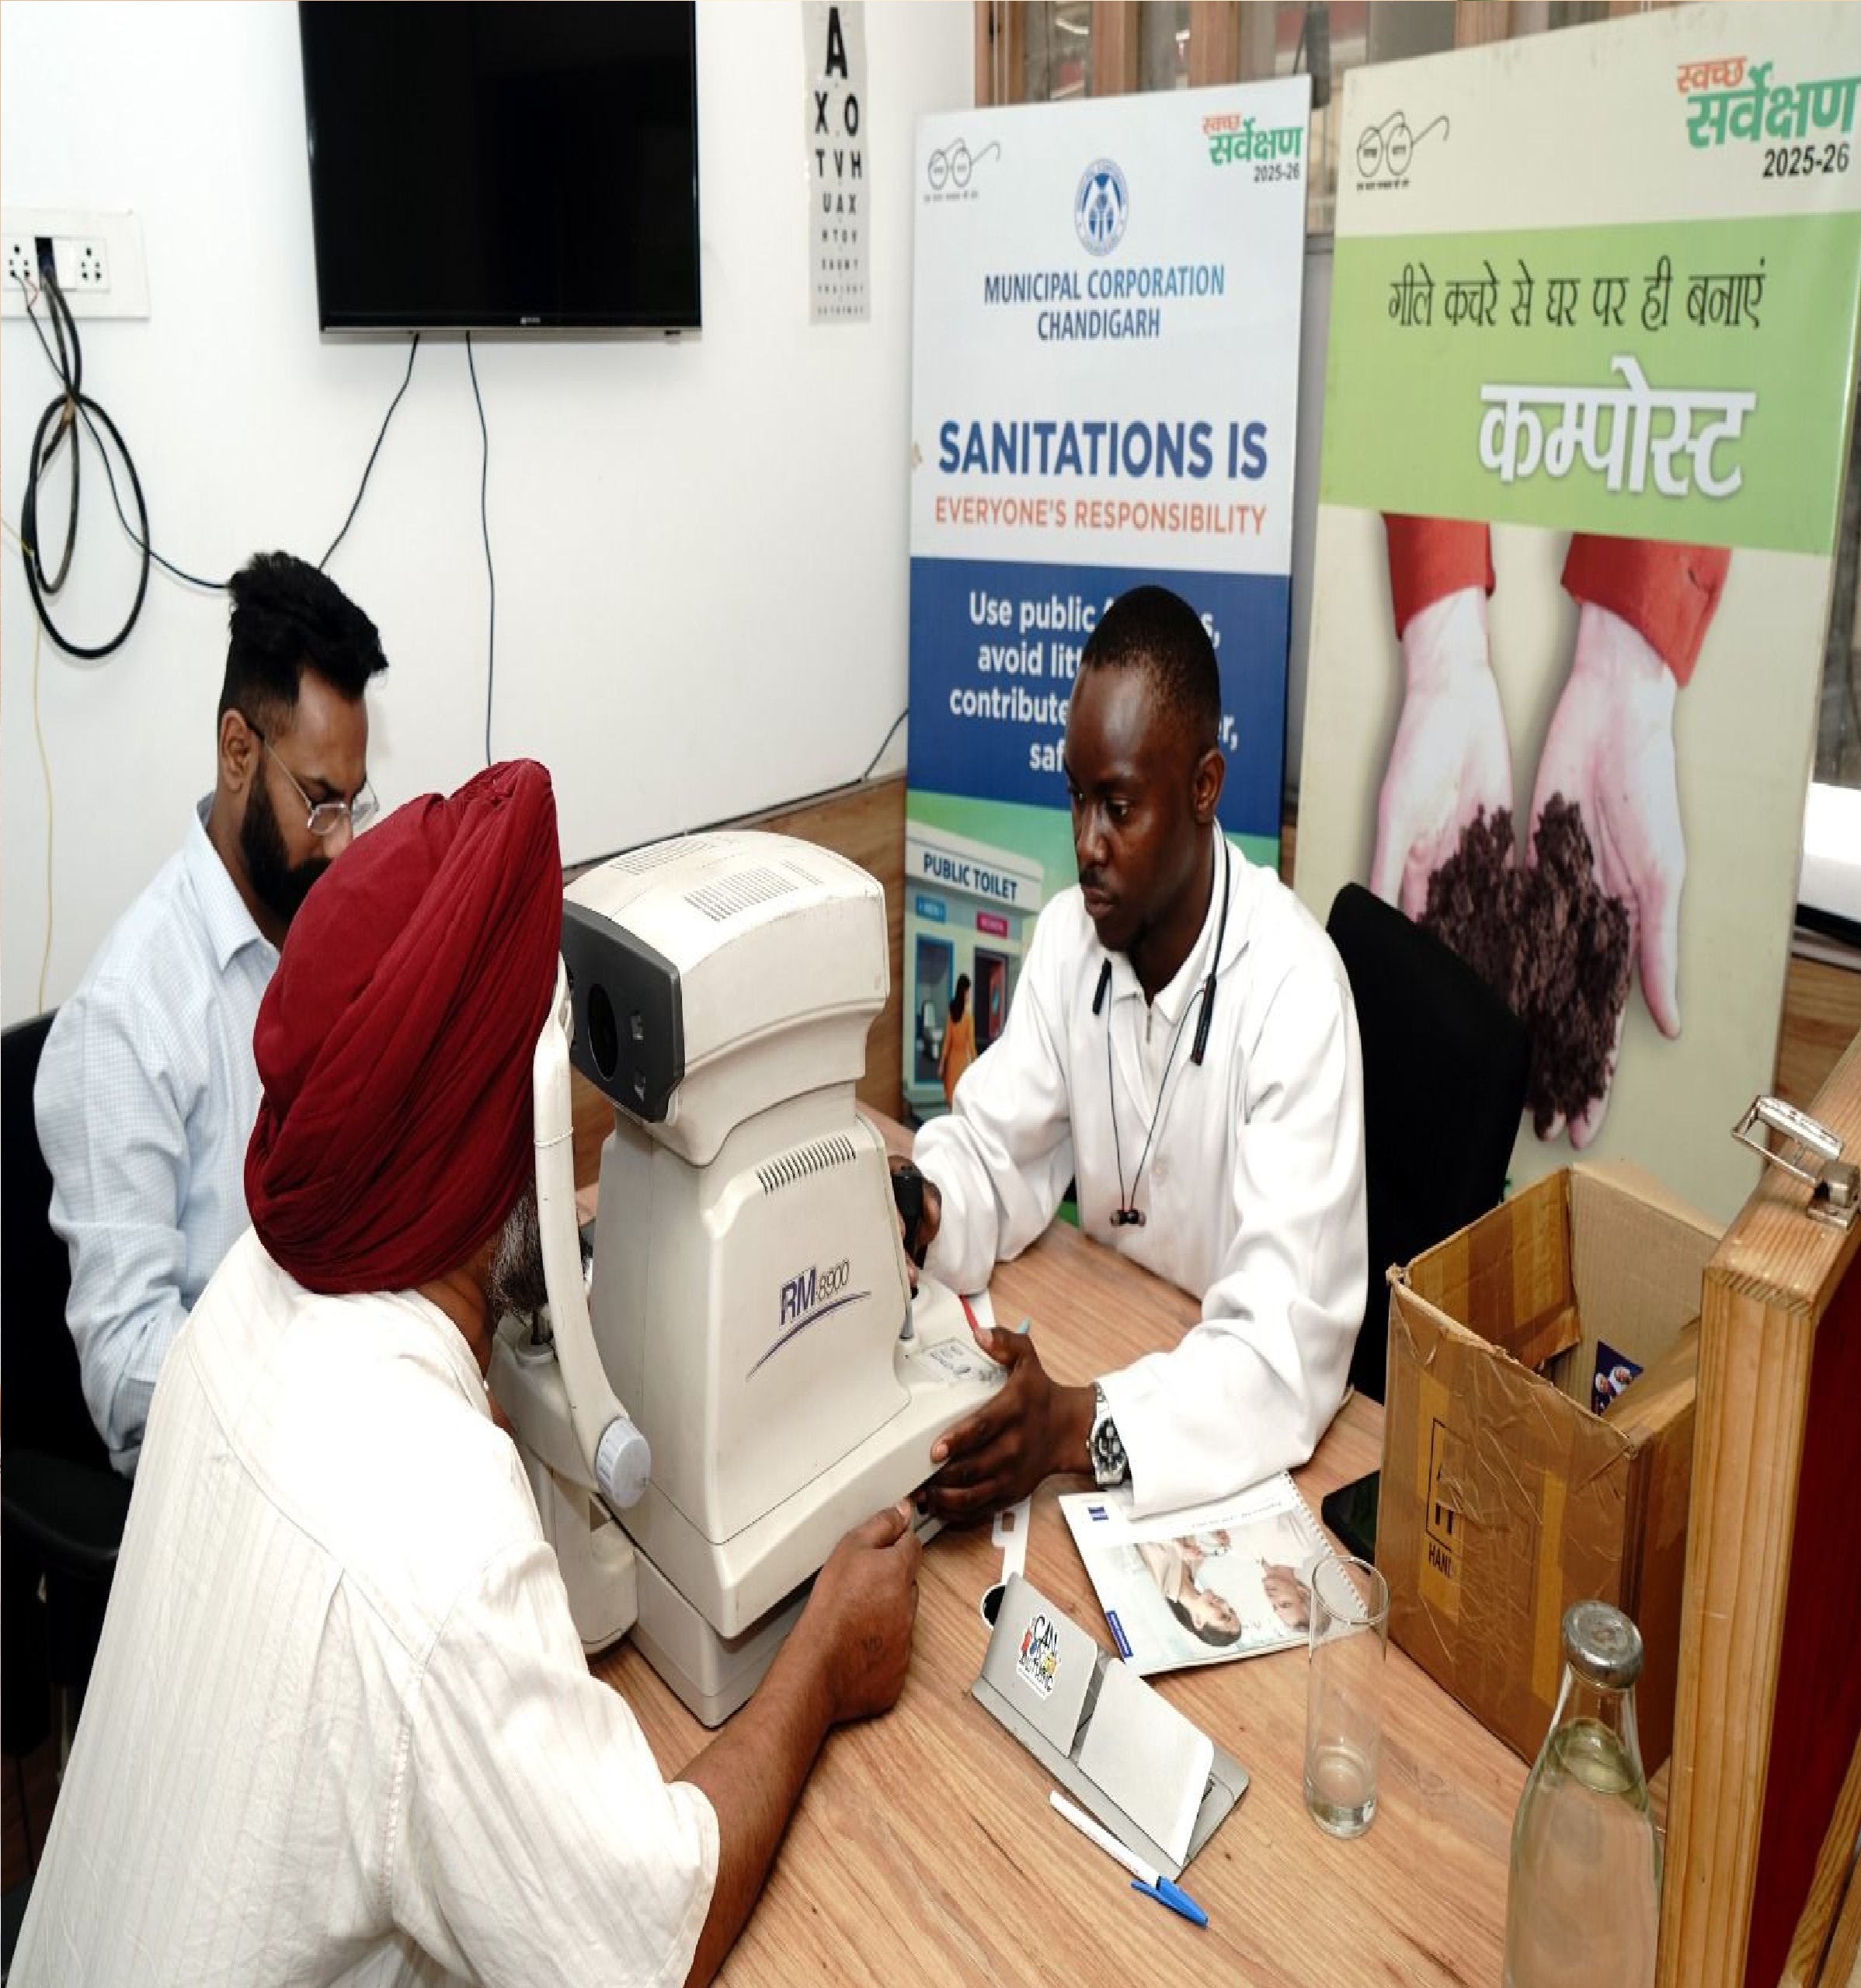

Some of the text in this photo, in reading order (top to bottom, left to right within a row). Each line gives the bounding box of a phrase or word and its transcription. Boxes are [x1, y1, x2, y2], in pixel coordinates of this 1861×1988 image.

[825, 7, 847, 79] A
[1677, 57, 1748, 94] स्वच्छ
[1685, 62, 1861, 149] सर्वेक्षण
[1209, 116, 1303, 165] सर्वेक्षण
[1254, 163, 1299, 183] 2025-26
[1762, 144, 1850, 179] 2025-26
[984, 264, 1225, 304] MUNICIPAL CORPORATION
[1388, 255, 1767, 331] गीले कचरे से घर पर ही बनाएं
[1038, 308, 1160, 342] CHANDIGARH
[1479, 354, 1757, 498] कम्पोस्ट
[939, 420, 1268, 480] SANITATIONS IS
[934, 496, 1267, 536] EVERYONE'S RESPONSIBILITY
[969, 592, 1012, 626] Use
[1019, 594, 1095, 634] public
[978, 643, 1042, 677] avoid
[949, 686, 1069, 726] contribute
[924, 853, 1017, 902] PUBLIC TOILET
